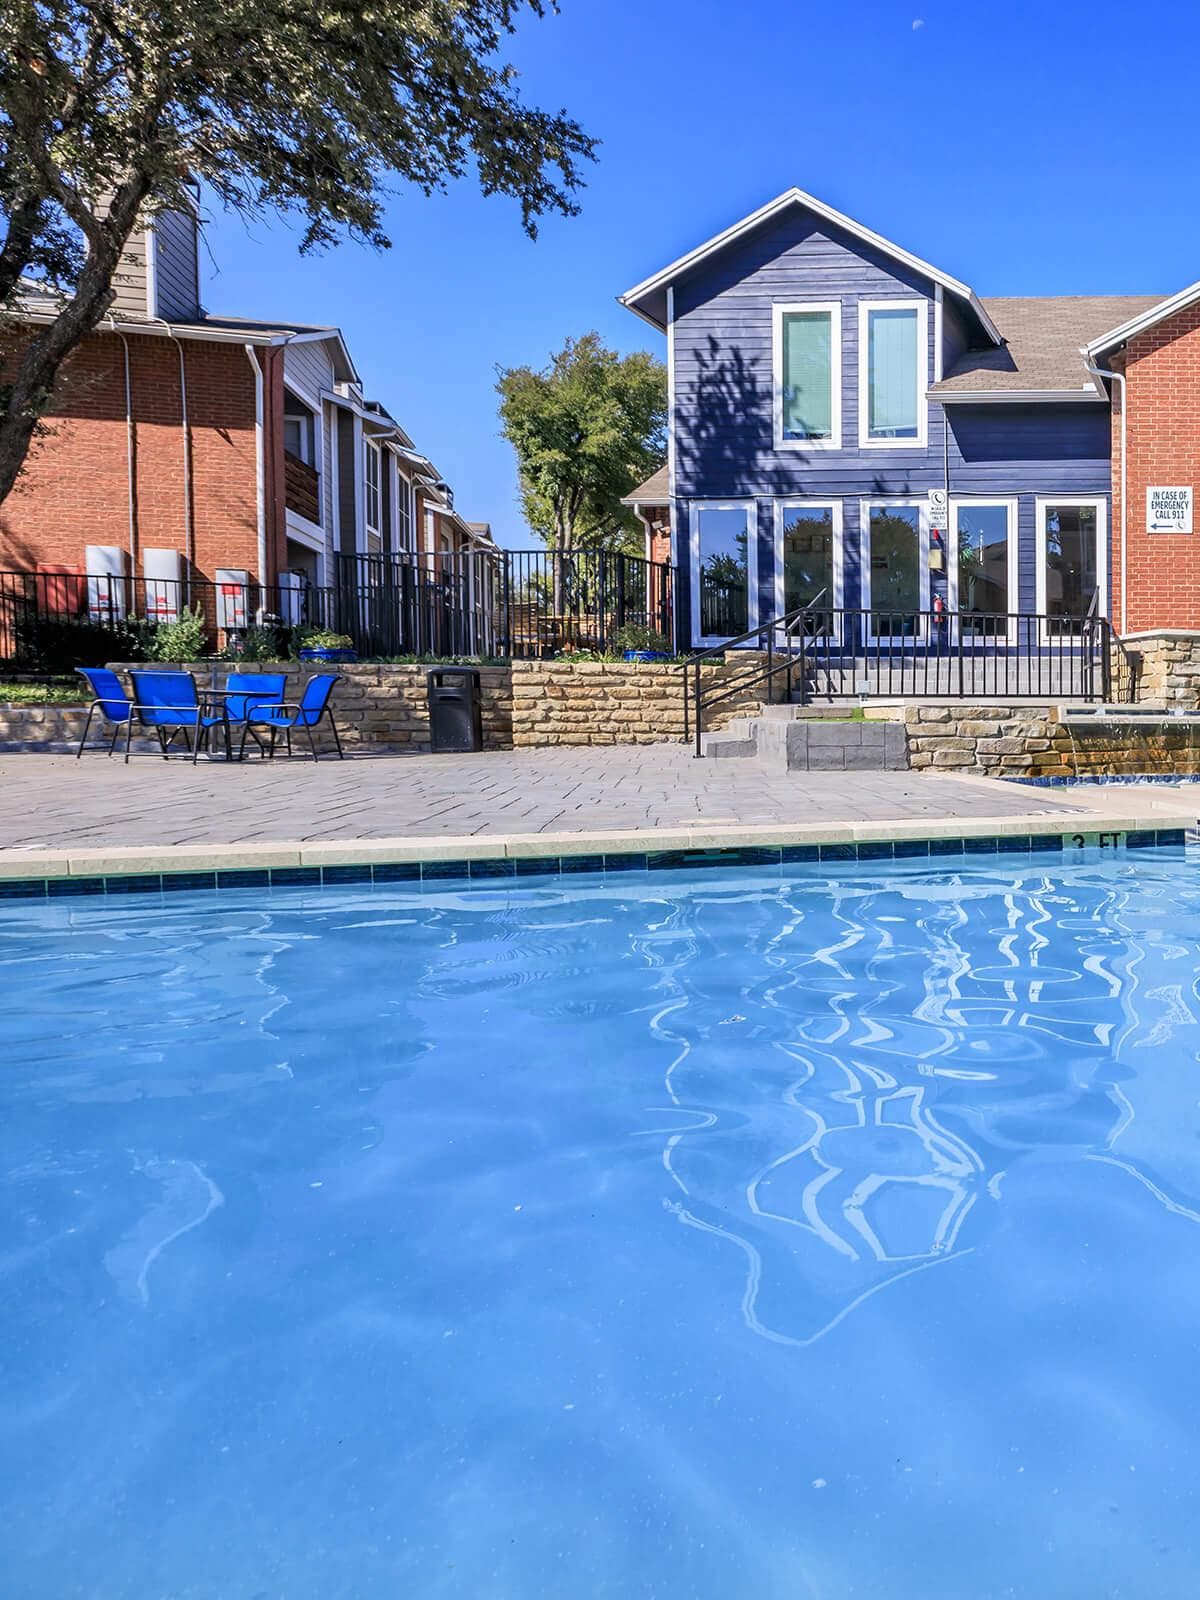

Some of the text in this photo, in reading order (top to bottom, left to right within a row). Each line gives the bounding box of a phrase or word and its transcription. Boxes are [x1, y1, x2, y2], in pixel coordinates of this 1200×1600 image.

[1152, 491, 1187, 500] IN CASE OF
[1151, 501, 1189, 510] EMERGENCY
[1155, 510, 1185, 519] CALL 911
[1099, 832, 1121, 848] FT
